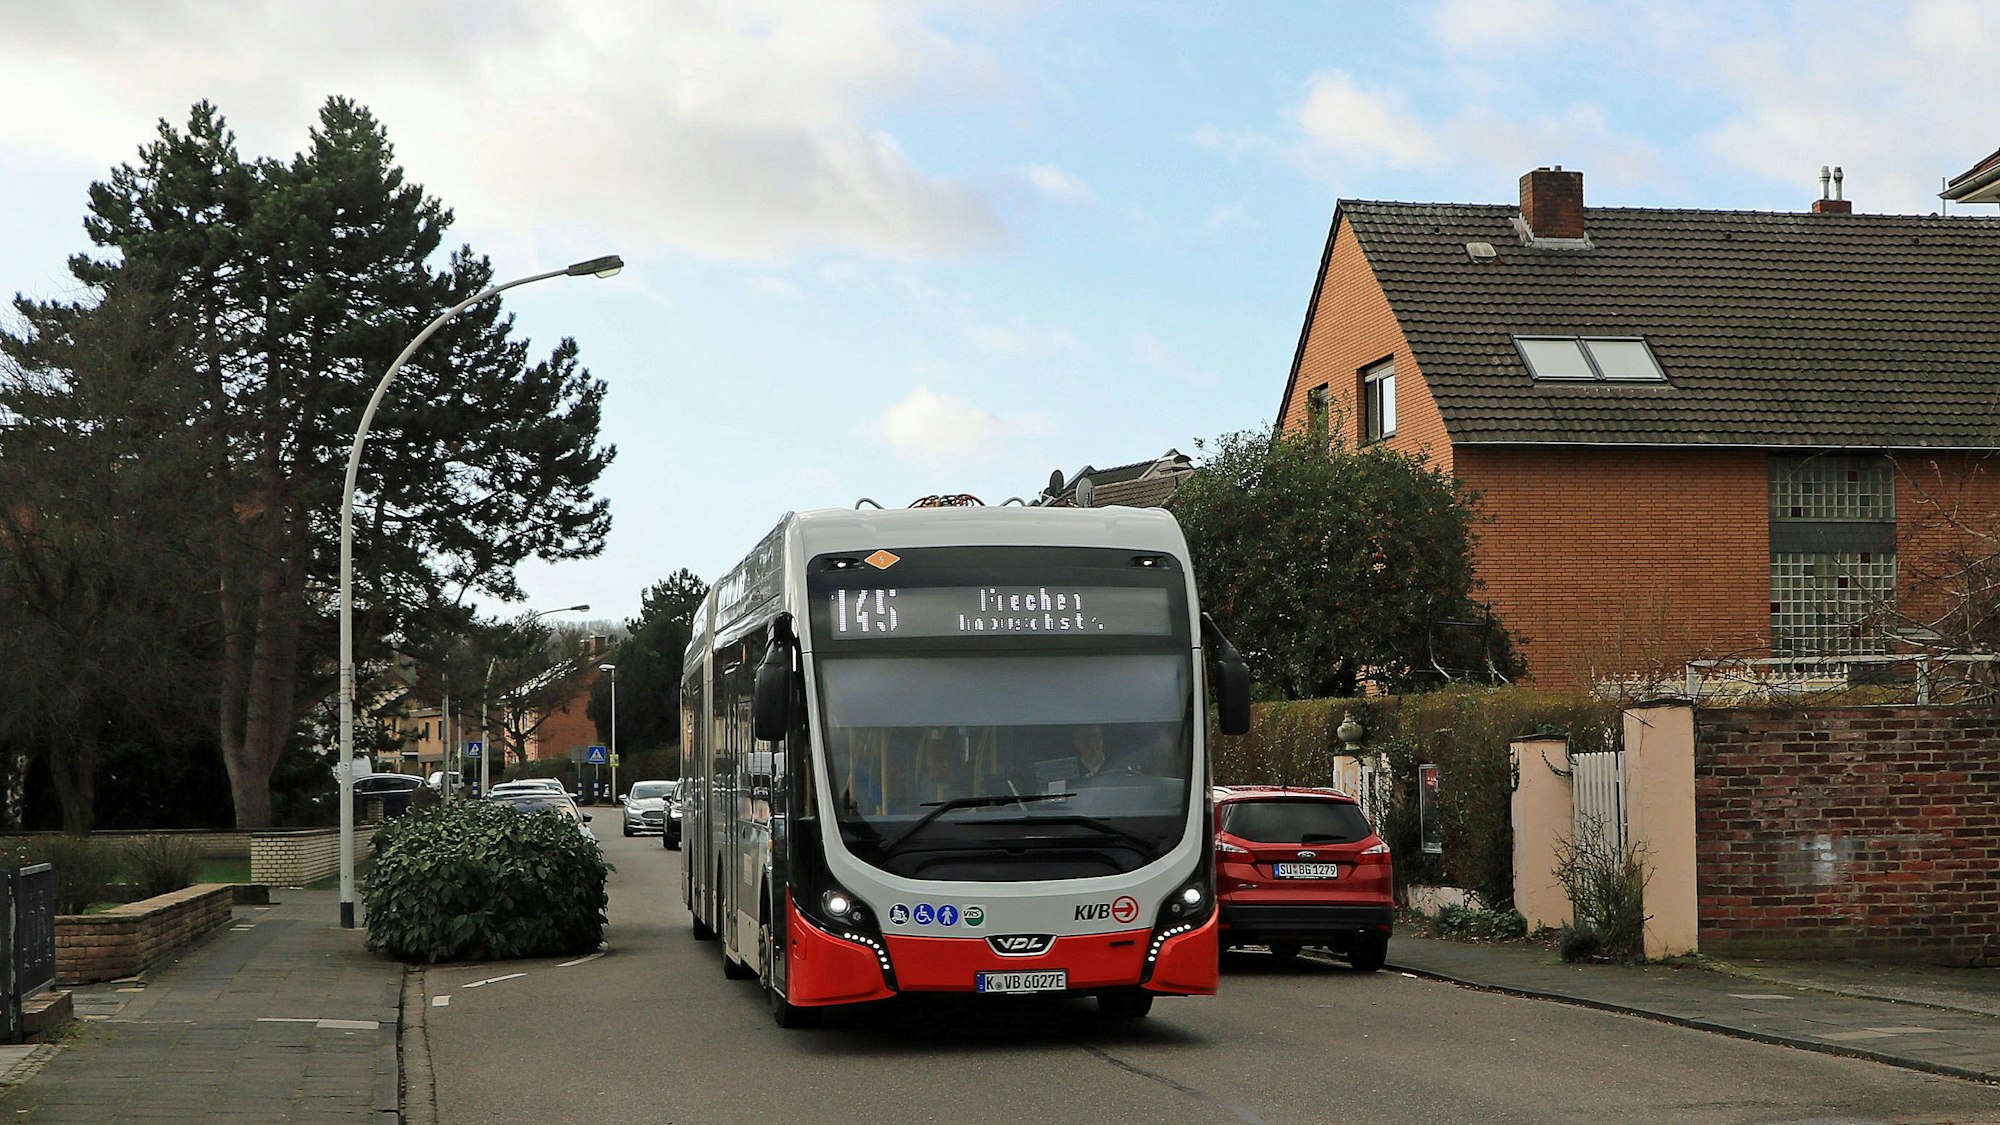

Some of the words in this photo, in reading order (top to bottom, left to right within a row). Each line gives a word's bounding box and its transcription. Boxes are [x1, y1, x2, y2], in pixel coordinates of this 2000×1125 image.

[831, 588, 898, 632] 145
[1280, 864, 1292, 875] SU
[1299, 864, 1311, 875] BG
[1312, 864, 1336, 875] 1279
[1074, 903, 1111, 921] KVB
[997, 937, 1043, 950] VDL
[986, 976, 994, 990] K
[1004, 975, 1021, 990] VB
[1024, 974, 1064, 989] 6027E
